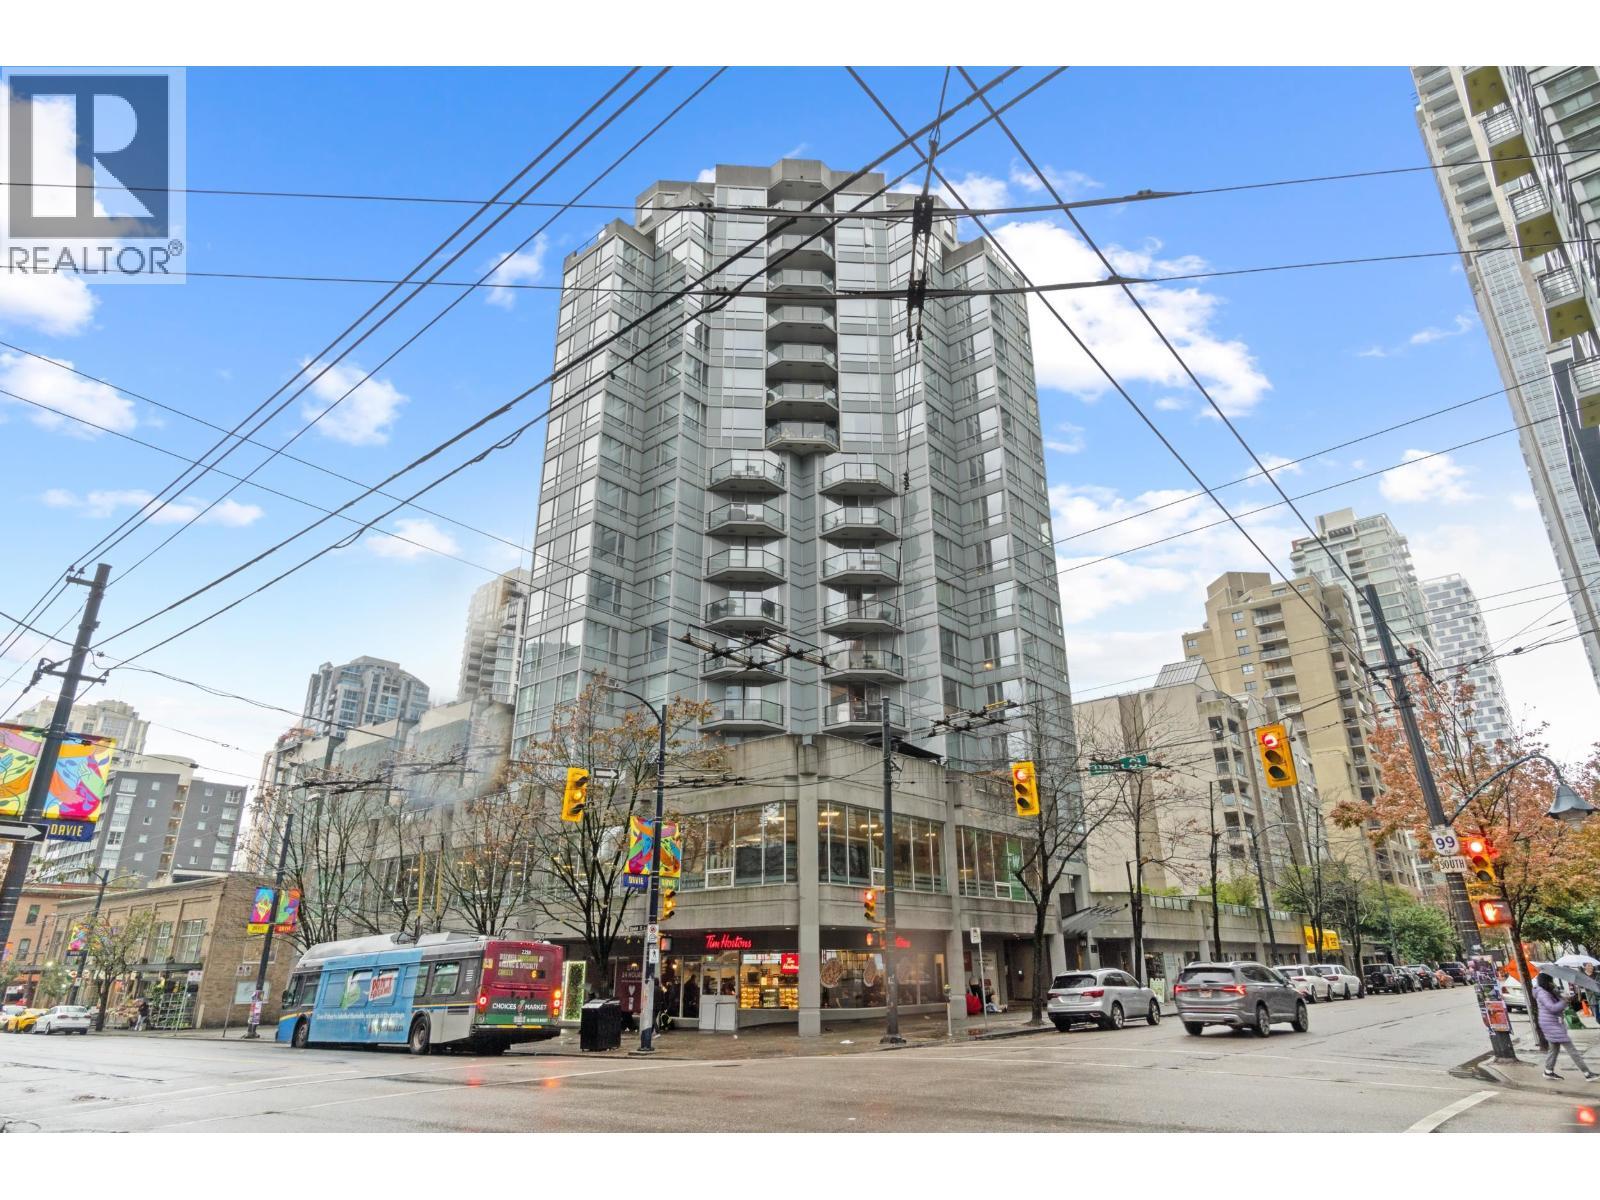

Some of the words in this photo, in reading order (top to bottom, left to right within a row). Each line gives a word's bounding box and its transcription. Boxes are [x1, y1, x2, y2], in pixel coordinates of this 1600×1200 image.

[50, 823, 84, 837] DAVIE
[1435, 836, 1455, 850] 99
[1440, 859, 1465, 870] SOUTH
[706, 934, 720, 949] Tim
[720, 934, 752, 949] Hortons
